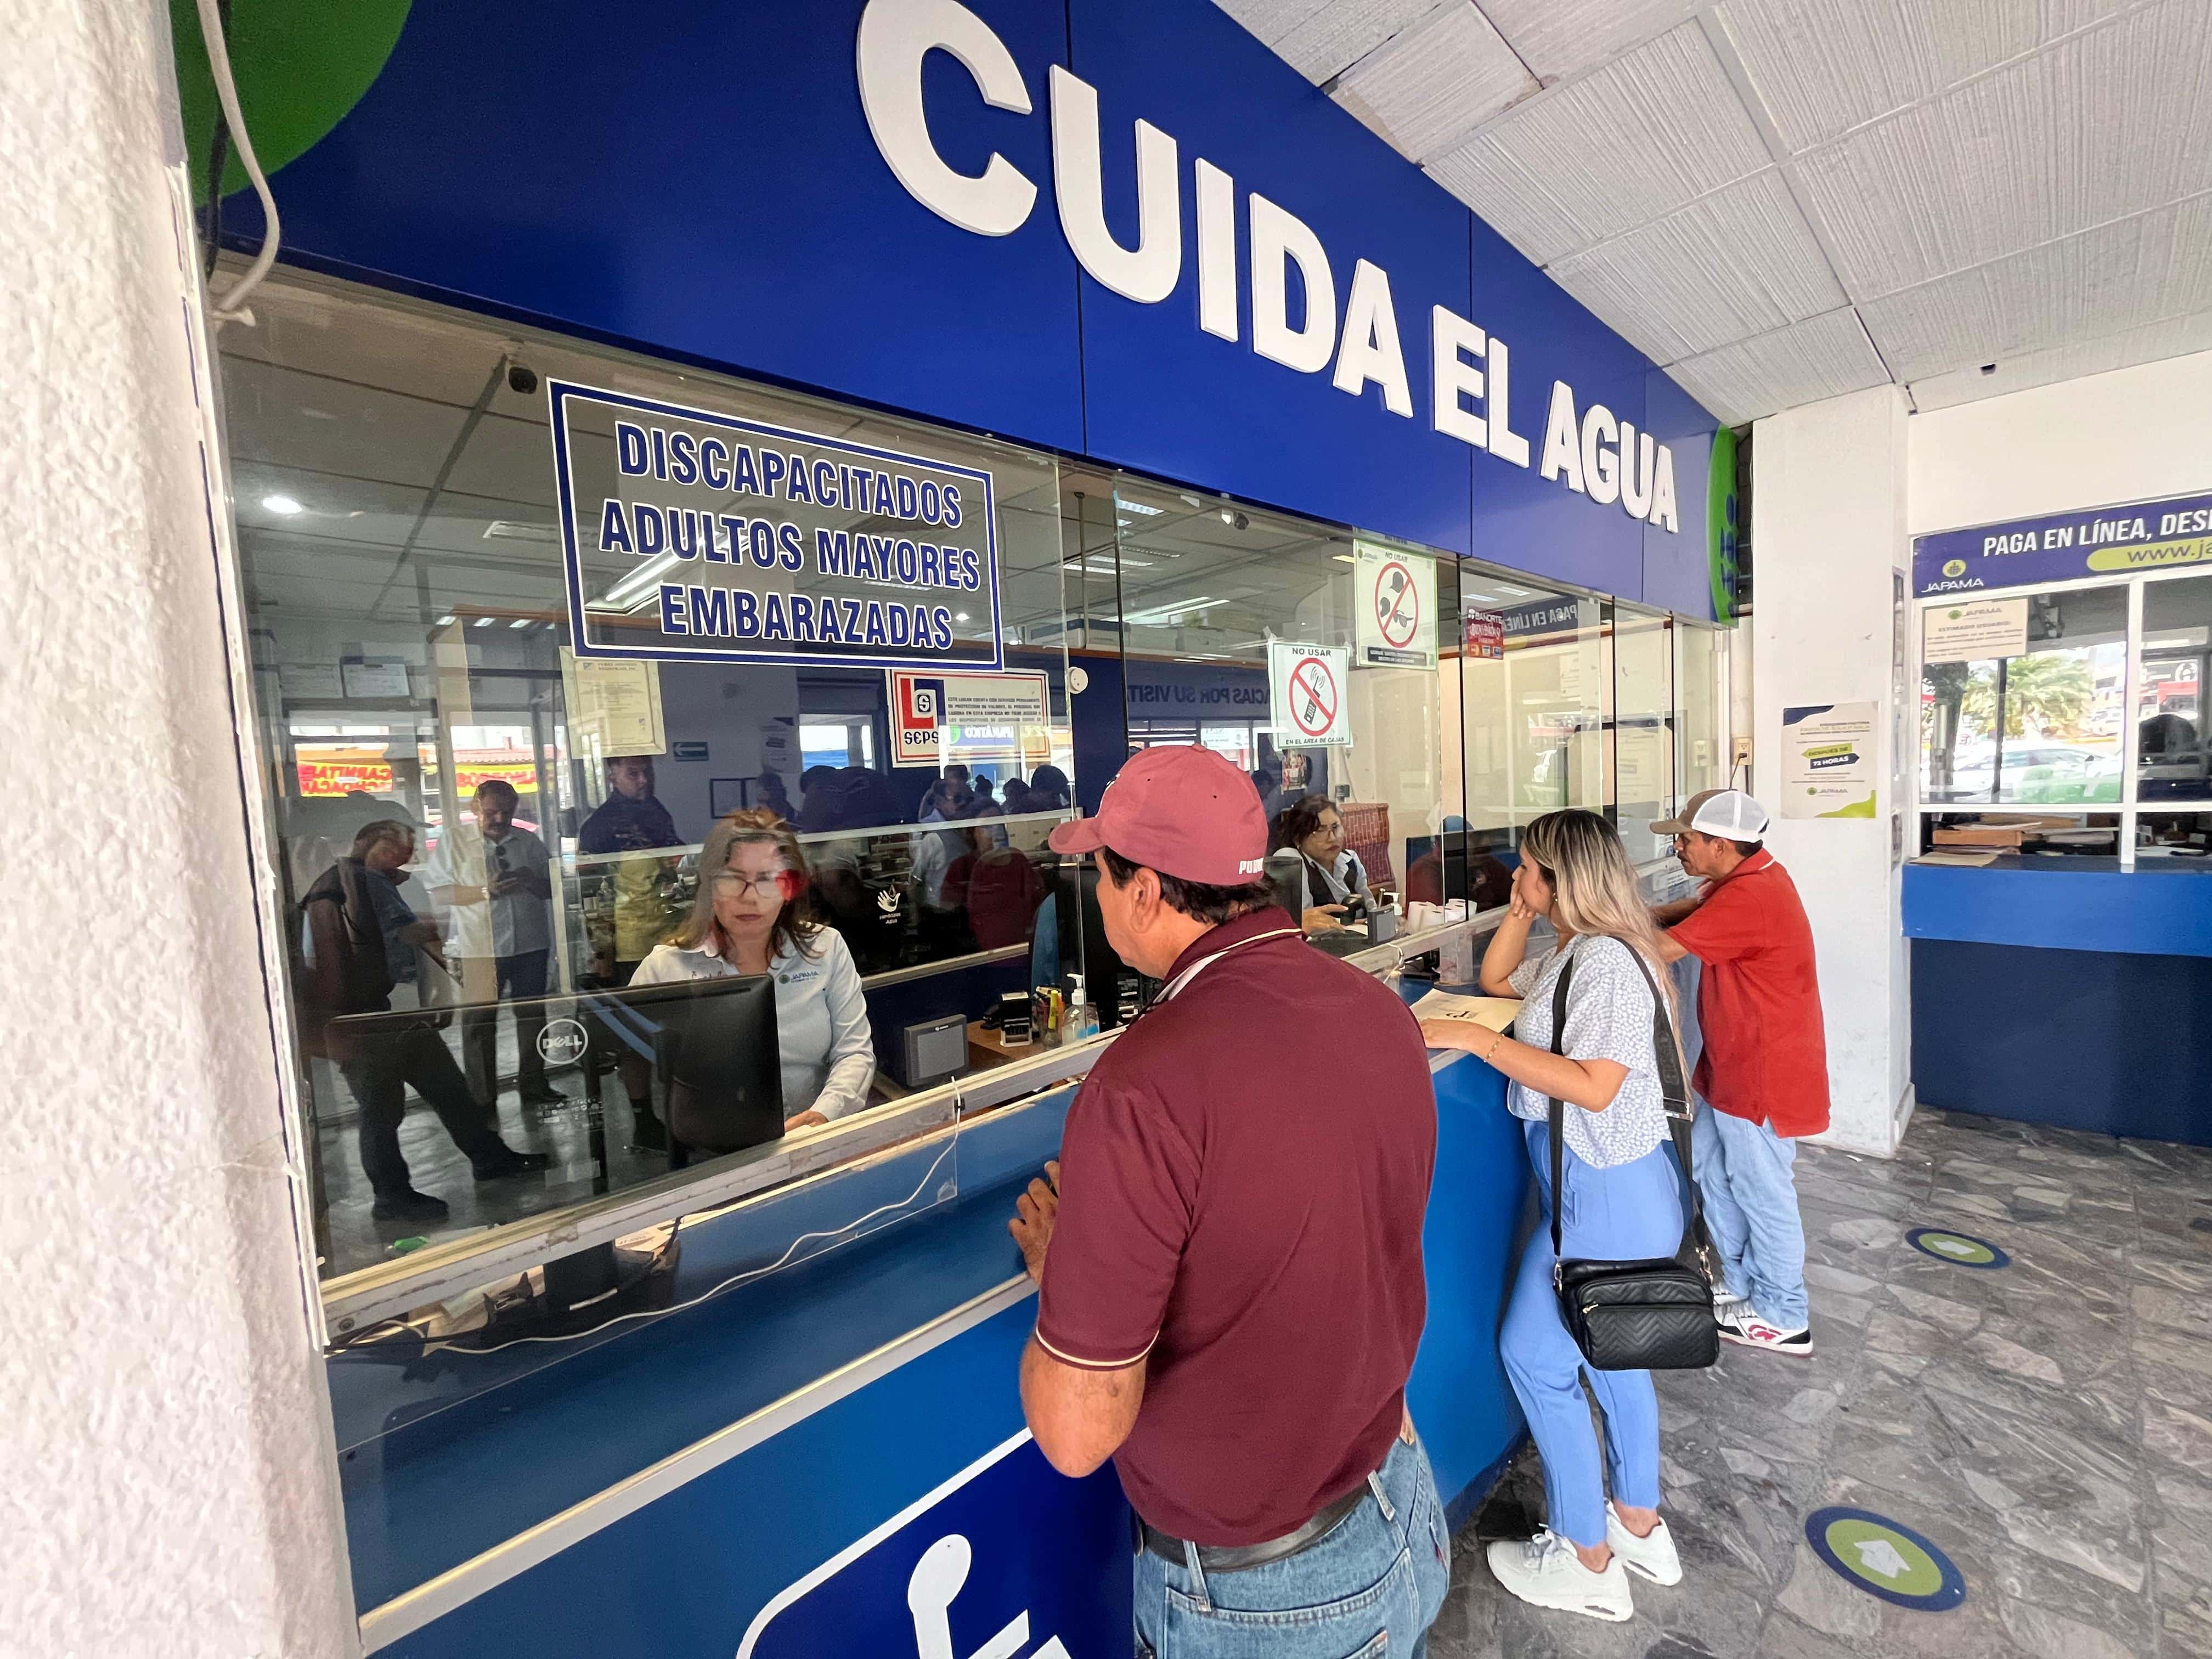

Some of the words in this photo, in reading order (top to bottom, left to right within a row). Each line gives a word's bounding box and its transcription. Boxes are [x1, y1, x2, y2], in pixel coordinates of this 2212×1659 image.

[856, 0, 1413, 418] CUIDA
[1433, 304, 1529, 469] EL
[1541, 379, 1679, 533] AGUA
[614, 420, 962, 530] DISCAPACITADOS
[599, 498, 805, 572] ADULTOS
[816, 528, 980, 592] MAYORES
[1983, 532, 2037, 557] PAGA
[2044, 526, 2073, 550] EN
[2079, 518, 2152, 545] LÍNEA,
[1393, 554, 1408, 562] USAR
[1921, 578, 1984, 593] JAPAMA
[658, 583, 953, 651] EMBARAZADAS
[904, 731, 939, 745] SEPS
[1822, 755, 1849, 765] HORAS
[543, 1034, 583, 1049] DELL
